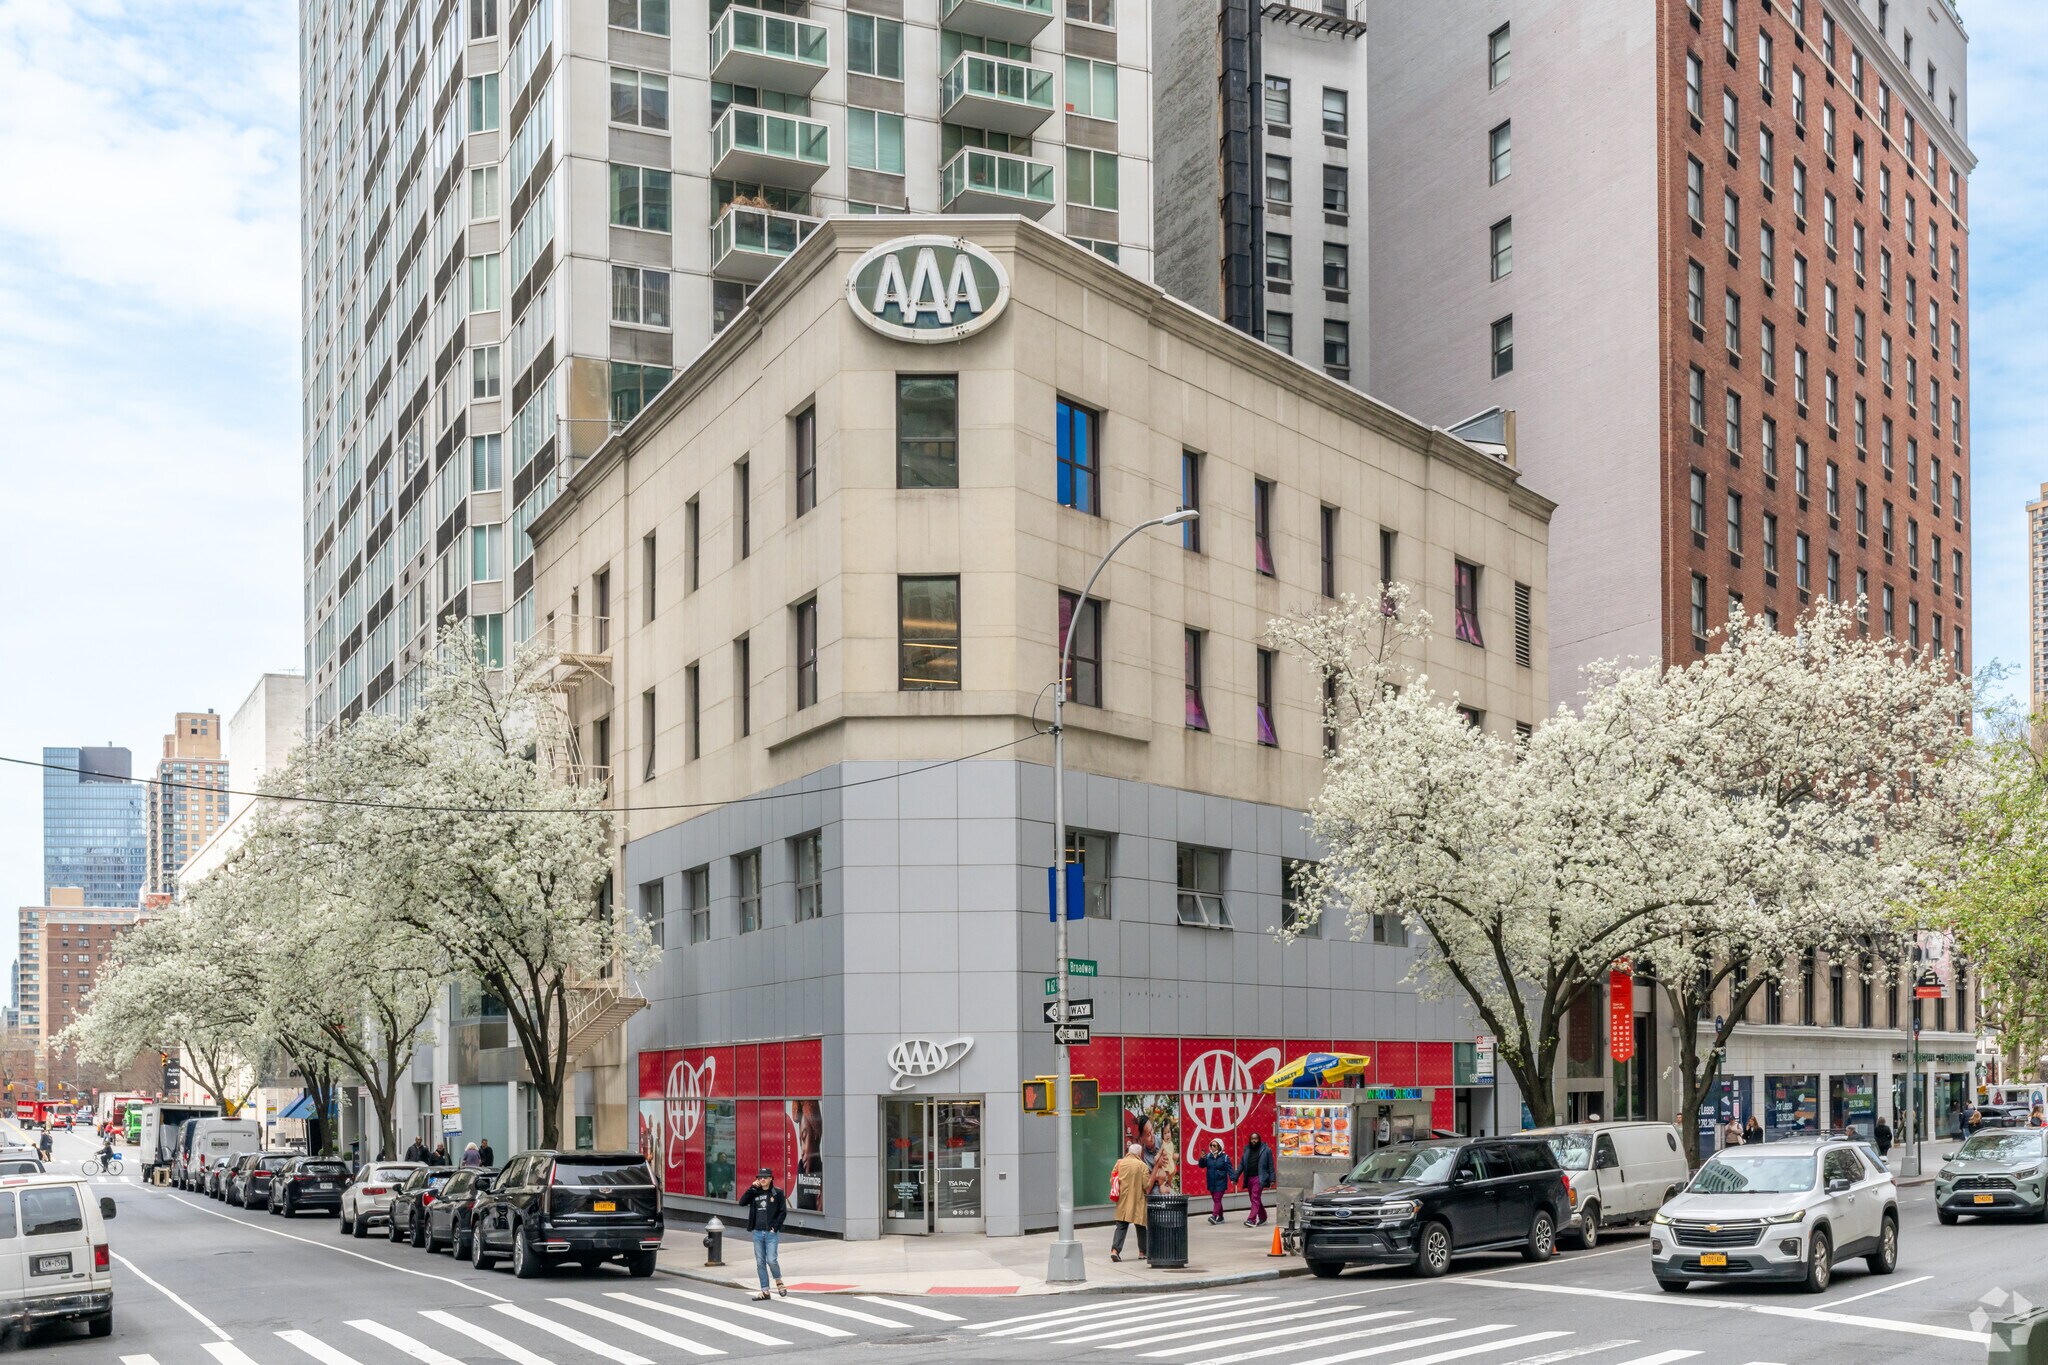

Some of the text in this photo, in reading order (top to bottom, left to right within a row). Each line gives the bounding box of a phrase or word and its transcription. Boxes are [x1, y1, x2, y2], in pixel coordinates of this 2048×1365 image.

[873, 247, 983, 325] AAA
[1070, 960, 1095, 976] Broadway
[1071, 1005, 1087, 1015] WAY
[1059, 1032, 1087, 1040] ONE WAY
[893, 1040, 944, 1074] AAA
[1273, 1071, 1297, 1084] SABRETT
[1190, 1052, 1249, 1130] AAA
[669, 1063, 700, 1138] AAA
[798, 1173, 821, 1186] Maximize
